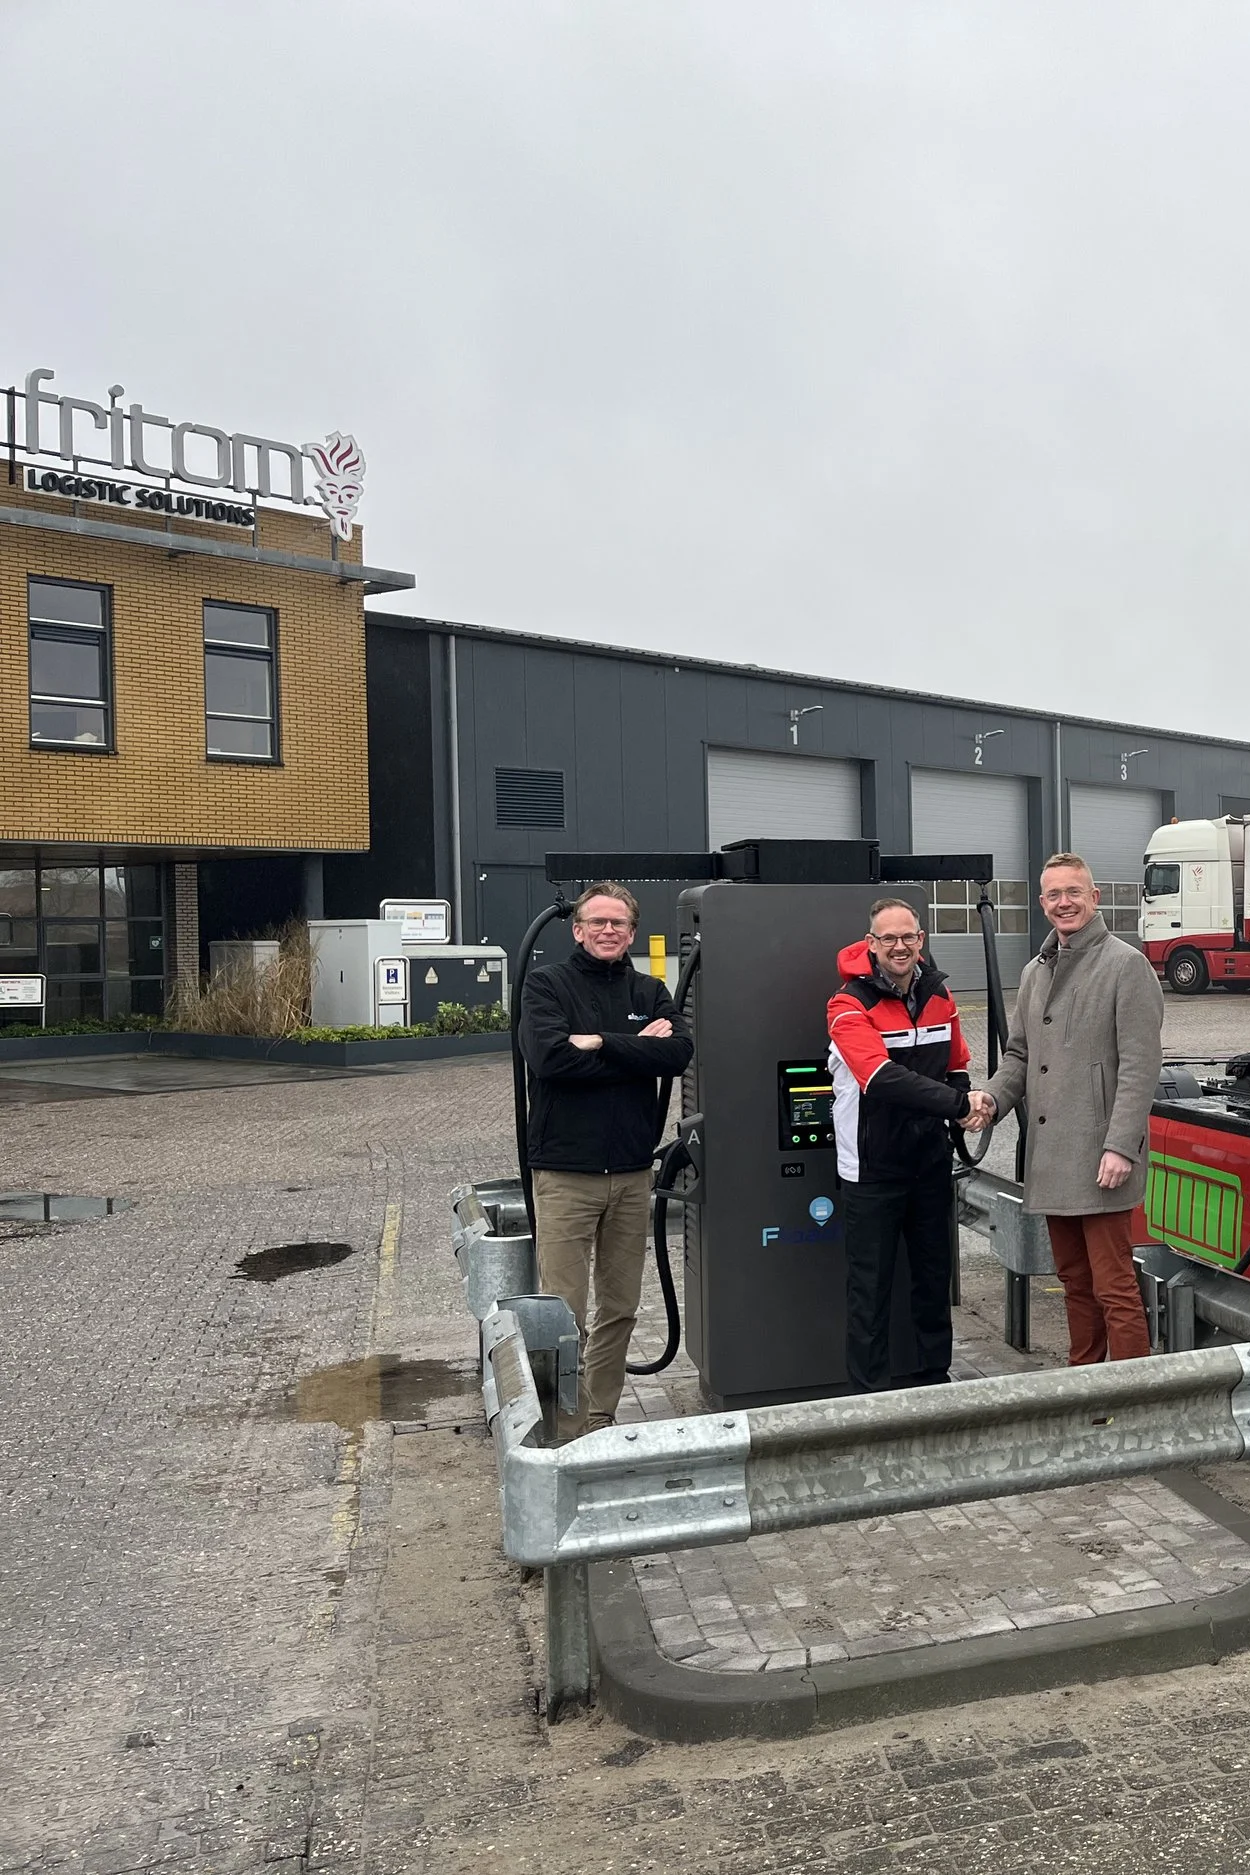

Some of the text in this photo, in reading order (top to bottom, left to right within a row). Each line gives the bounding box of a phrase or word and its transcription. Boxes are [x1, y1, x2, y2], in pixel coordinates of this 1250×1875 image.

[25, 368, 304, 505] fritom
[27, 468, 255, 527] LOGISTIC SOLUTIONS
[790, 724, 798, 745] 1
[974, 746, 983, 766] 2
[1120, 764, 1127, 780] 3
[687, 1129, 701, 1145] A
